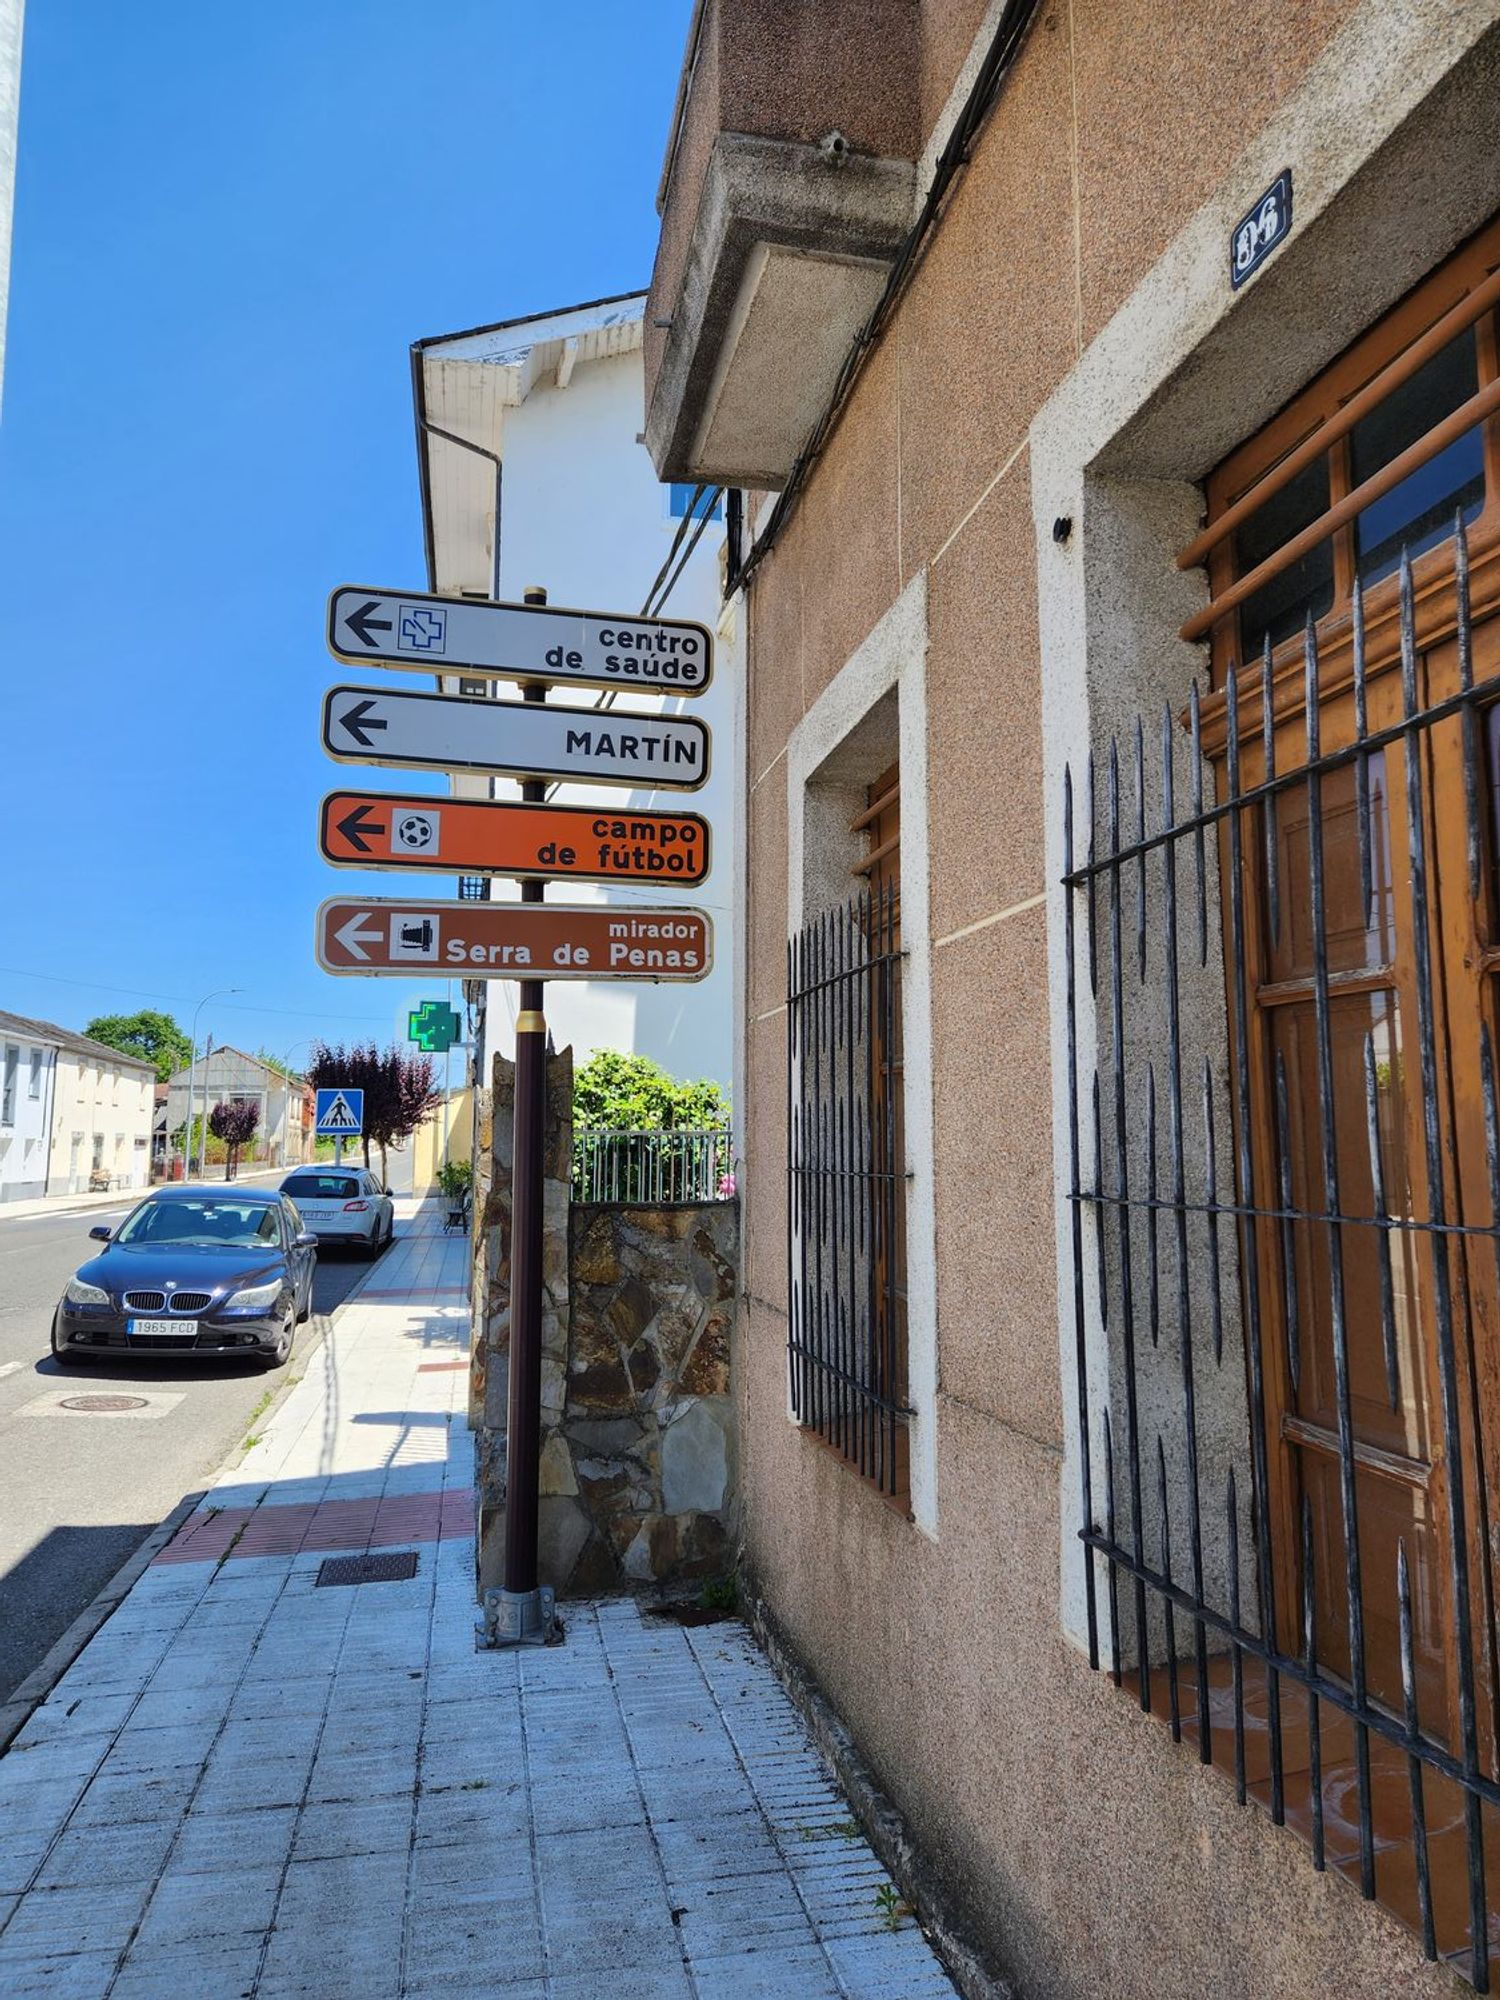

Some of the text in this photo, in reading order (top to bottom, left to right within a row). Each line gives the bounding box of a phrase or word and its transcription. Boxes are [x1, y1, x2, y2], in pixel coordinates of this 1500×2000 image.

[598, 629, 699, 655] centro
[545, 646, 698, 681] de saúde
[566, 730, 696, 765] MARTÍN
[592, 819, 697, 847] campo
[537, 842, 696, 873] de fútbol
[609, 919, 699, 939] mirador
[446, 938, 699, 968] Serra de Penas
[137, 1321, 194, 1334] 1965 FCD
